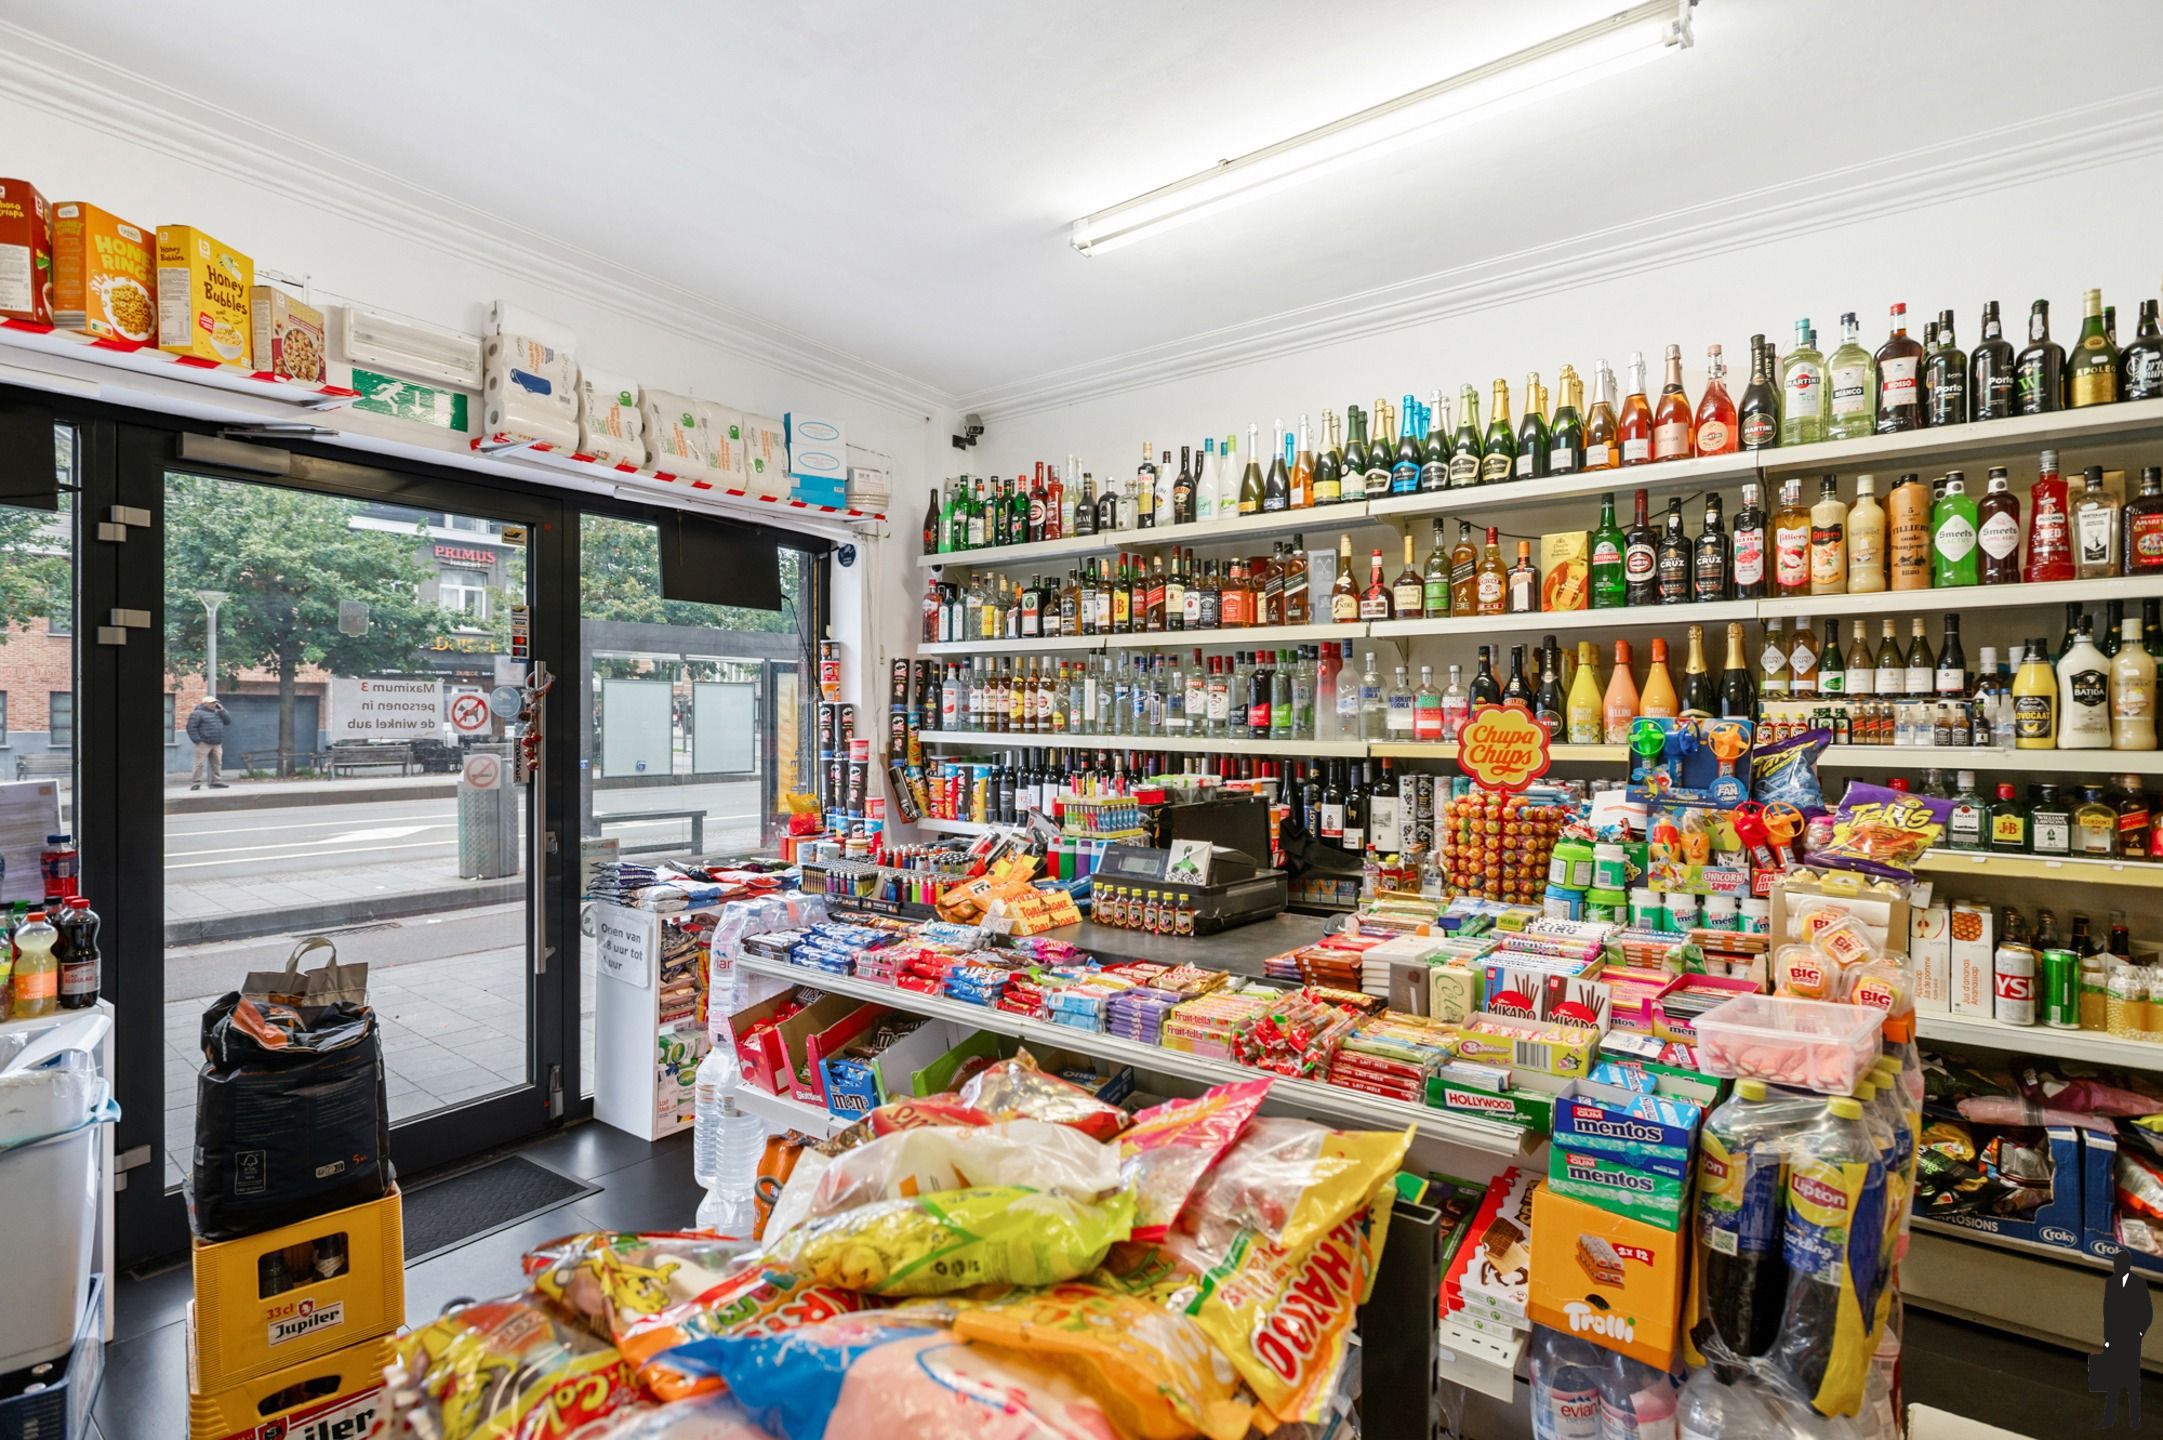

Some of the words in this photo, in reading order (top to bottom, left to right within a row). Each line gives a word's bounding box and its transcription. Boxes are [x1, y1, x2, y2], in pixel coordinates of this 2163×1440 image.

[206, 264, 245, 298] Honey
[204, 282, 248, 315] Bubbles
[2075, 364, 2117, 377] APOLEO
[1934, 383, 1963, 394] Porto
[1743, 424, 1773, 434] MARTINI
[1939, 529, 1973, 539] Smeets
[1983, 527, 2018, 536] Smeets
[434, 545, 496, 564] PRIMUS
[1696, 556, 1722, 565] CRUZ
[1660, 560, 1685, 568] CRUZ
[2074, 688, 2105, 696] BATIDA
[1472, 725, 1535, 751] Chupa
[1469, 746, 1532, 777] Chups
[1717, 786, 1738, 796] FAN
[1849, 799, 1935, 829] Takis
[1703, 872, 1745, 883] UNICORN
[1711, 883, 1737, 891] SPRAY
[626, 931, 641, 944] van
[613, 945, 629, 955] uur
[631, 948, 643, 961] tot
[608, 959, 623, 970] uur
[1790, 968, 1819, 980] BIG
[1860, 990, 1891, 1006] BIG
[1175, 1011, 1211, 1025] Fruit-tella
[1488, 1003, 1537, 1020] MIKADO
[1548, 1012, 1600, 1030] MIKADO
[1167, 1024, 1203, 1040] Fruit-tella
[1063, 1070, 1097, 1080] OREO
[1448, 1092, 1512, 1111] HOLLYWOOD
[1485, 1109, 1514, 1120] Chewing
[1514, 1112, 1533, 1121] Gum
[1576, 1109, 1604, 1120] GUM
[1575, 1119, 1663, 1142] mentos
[1570, 1158, 1597, 1168] GUM
[1568, 1166, 1655, 1192] mentos
[1793, 1175, 1846, 1208] Lipton
[2042, 1228, 2076, 1244] Croky
[1617, 1245, 1633, 1258] 2x
[1634, 1249, 1650, 1263] 12
[274, 1309, 340, 1340] Jupiler
[1563, 1302, 1636, 1344] Trolli
